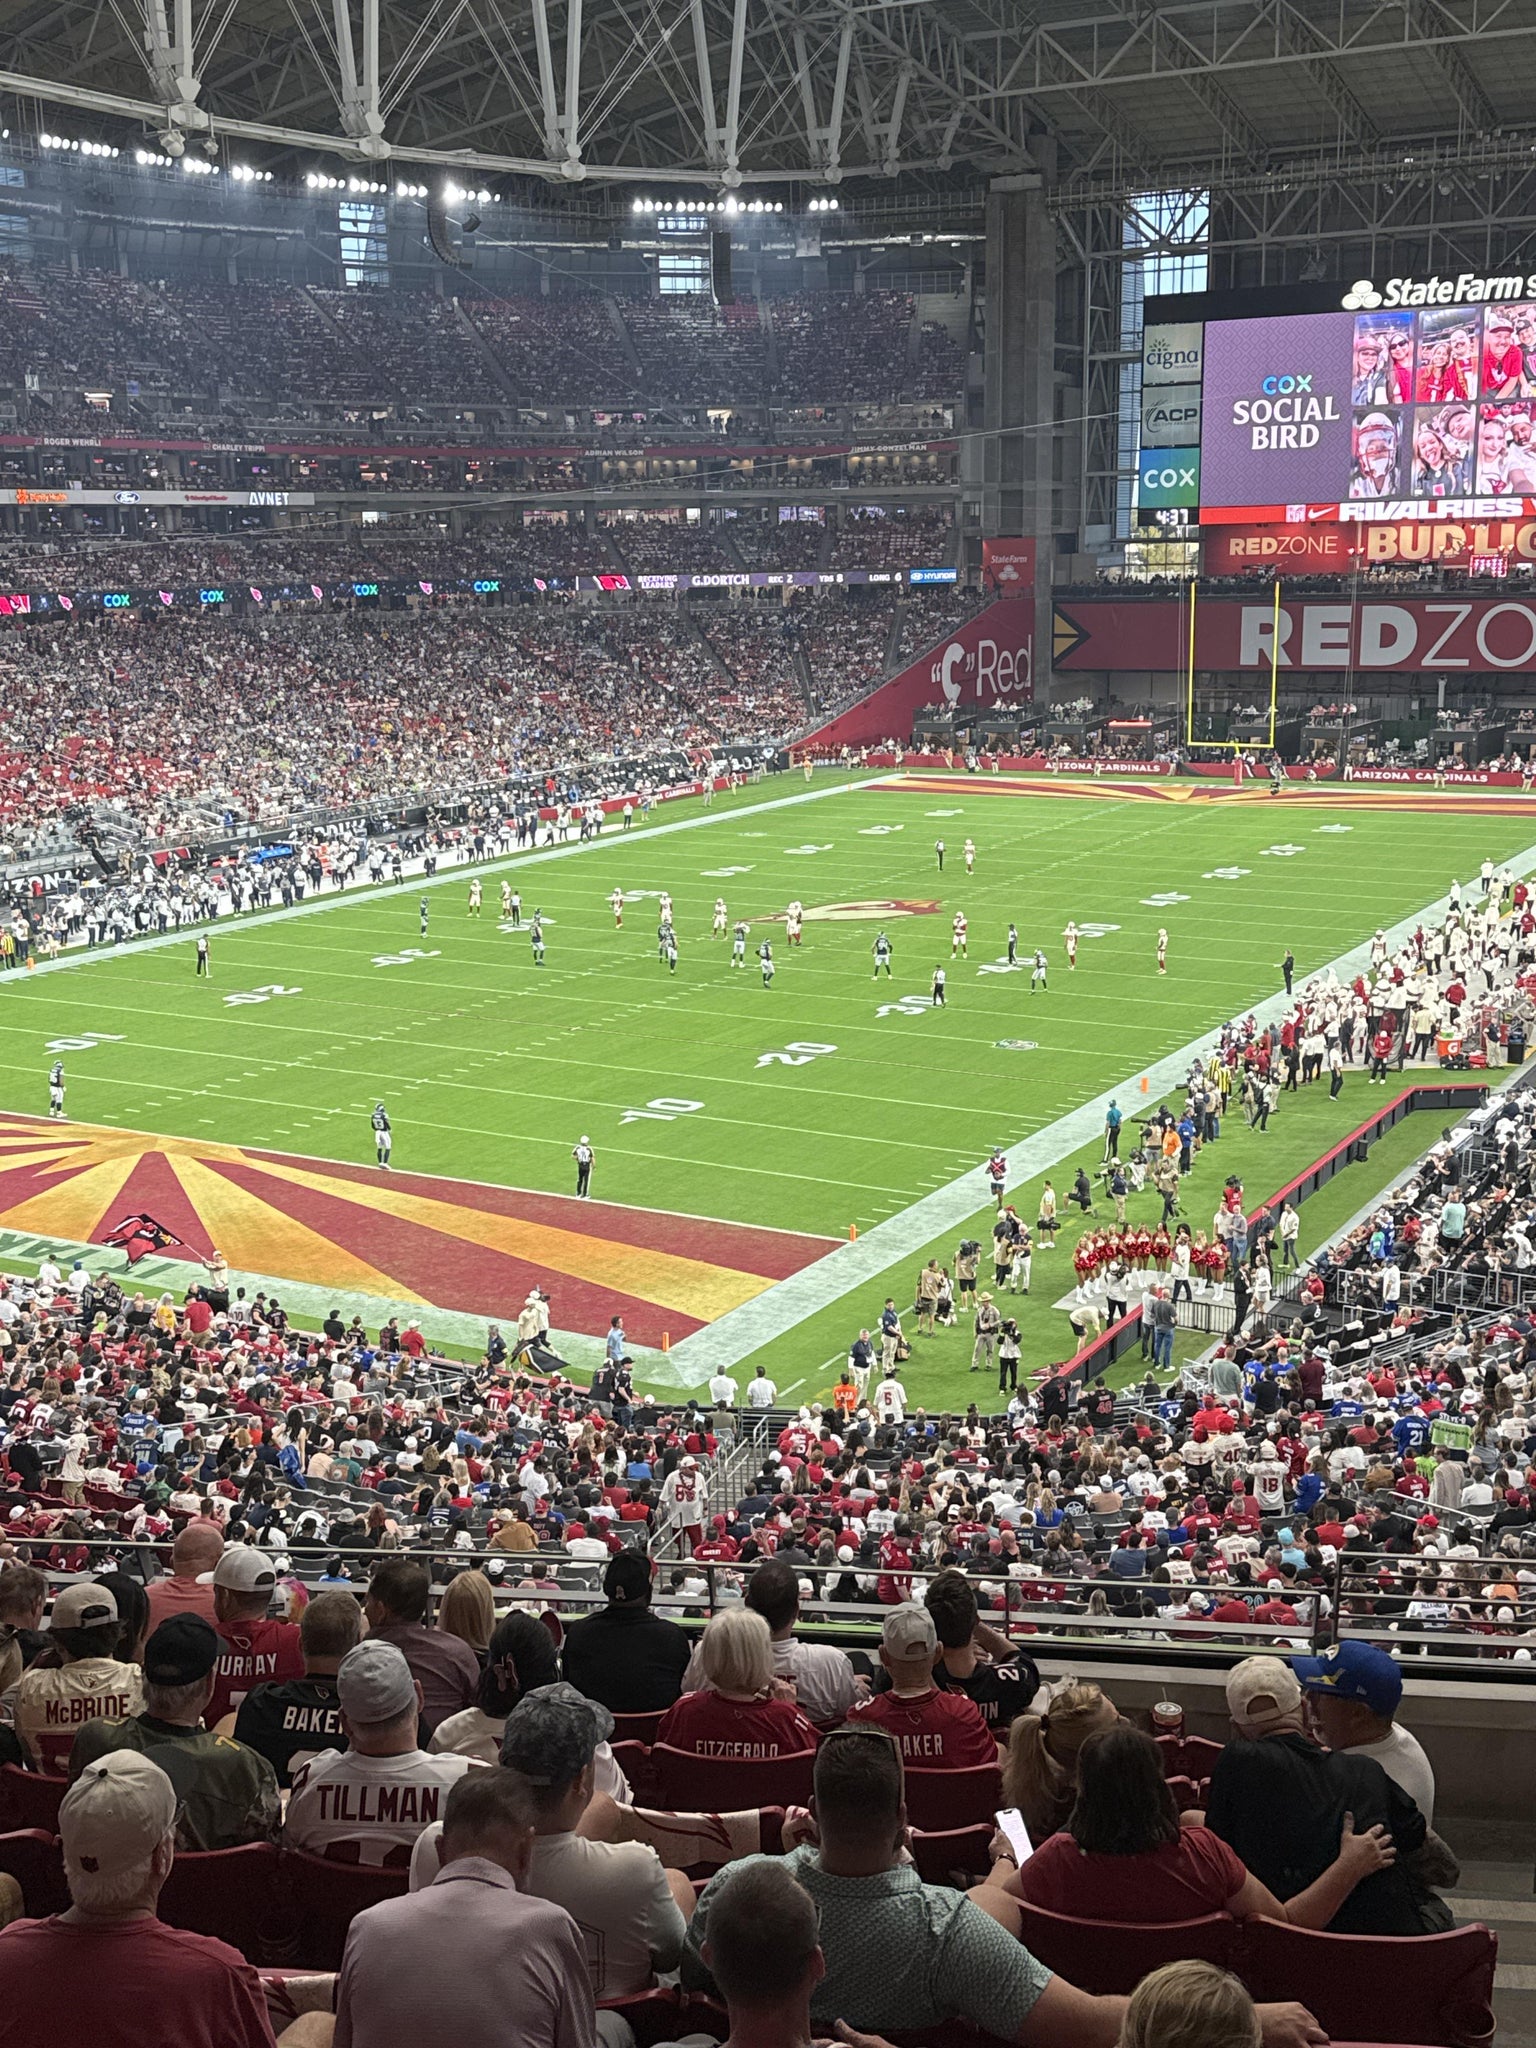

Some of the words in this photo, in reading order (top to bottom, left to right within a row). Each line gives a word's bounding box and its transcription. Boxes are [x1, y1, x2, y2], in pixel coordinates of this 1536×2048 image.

[1147, 349, 1199, 369] cigna
[1262, 374, 1313, 396] COX
[1153, 408, 1198, 422] ACP
[1233, 396, 1340, 425] SOCIAL
[44, 437, 70, 446] ROGER
[1251, 424, 1320, 450] BIRD
[212, 443, 243, 452] CHARLEY
[1143, 467, 1196, 489] COX
[249, 491, 289, 505] AVNET
[1156, 508, 1189, 526] 4:37
[1339, 498, 1523, 522] RIVALRIES
[1229, 535, 1338, 556] REDZONE
[1367, 525, 1467, 560] BUD
[692, 574, 750, 586] G.DORTCH
[768, 575, 784, 584] REC
[786, 573, 794, 583] 2
[836, 573, 844, 582] 8
[869, 574, 891, 582] LONG
[894, 572, 903, 582] 6
[354, 582, 379, 596] COX
[473, 580, 499, 593] COX
[103, 594, 130, 607] COX
[200, 589, 225, 603] COX
[1353, 770, 1410, 780] ARIZONA
[757, 1041, 838, 1066] 20
[620, 1097, 705, 1122] 10
[283, 1706, 344, 1734] BAKE
[317, 1785, 440, 1823] TILLMAN
